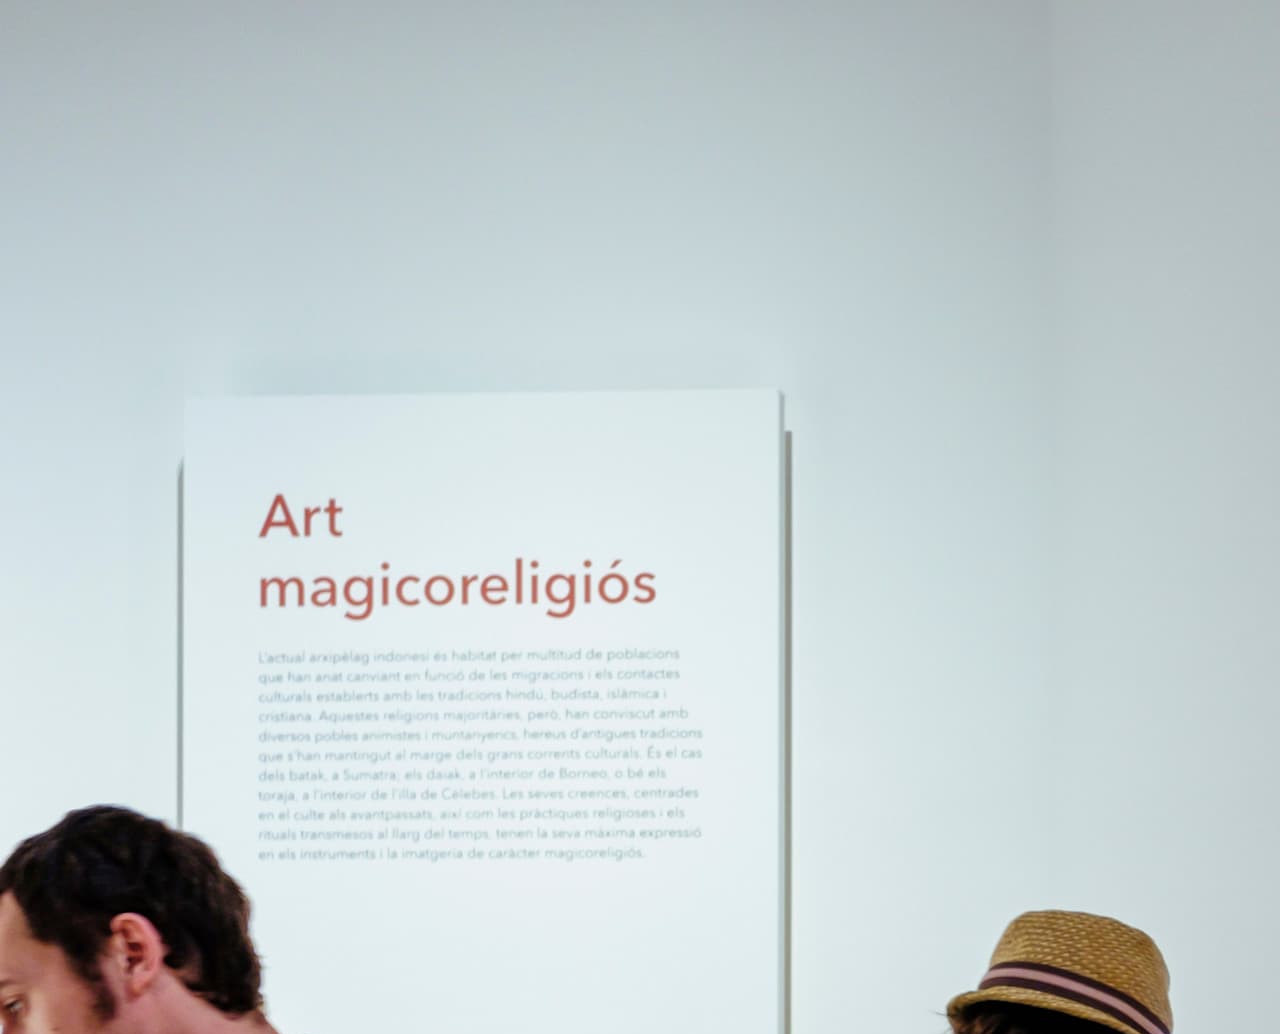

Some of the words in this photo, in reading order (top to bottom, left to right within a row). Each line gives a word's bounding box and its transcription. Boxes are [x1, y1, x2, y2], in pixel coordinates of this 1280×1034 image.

[259, 494, 342, 538] Art
[260, 559, 656, 621] magicoreligiós
[374, 649, 429, 663] indonesi
[452, 648, 496, 663] habitat
[501, 652, 522, 666] per
[526, 648, 582, 662] multitud
[606, 647, 679, 665] poblacions
[258, 673, 284, 687] que
[287, 669, 311, 683] han
[315, 669, 343, 683] anat
[425, 668, 464, 682] funció
[489, 667, 507, 682] les
[512, 668, 584, 685] migracions
[595, 667, 613, 681] els
[617, 667, 680, 681] contactes
[259, 689, 312, 704] culturals
[316, 689, 379, 703] establerts
[383, 688, 412, 702] amb
[416, 688, 434, 702] les
[438, 687, 502, 702] tradicions
[318, 709, 379, 726] Aquestes
[384, 707, 439, 725] religions
[565, 706, 590, 720] han
[593, 706, 655, 720] conviscut
[659, 705, 688, 719] amb
[259, 728, 310, 742] diversos
[315, 727, 358, 745] pobles
[362, 728, 421, 741] animistes
[523, 726, 567, 740] hereus
[640, 725, 702, 739] tradicions
[259, 751, 283, 765] que
[325, 748, 391, 765] mantingut
[410, 750, 452, 764] marge
[456, 746, 483, 761] dels
[487, 750, 524, 764] grans
[527, 747, 581, 760] corrents
[681, 749, 702, 759] cas
[258, 767, 285, 781] dels
[404, 766, 422, 780] els
[648, 765, 666, 779] els
[502, 787, 524, 800] Les
[528, 789, 564, 800] seves
[634, 785, 698, 799] centrades
[294, 806, 325, 820] culte
[329, 806, 346, 820] als
[465, 809, 493, 820] com
[497, 805, 516, 819] les
[593, 805, 656, 823] religioses
[667, 805, 684, 819] els
[259, 826, 296, 840] rituals
[300, 827, 373, 840] transmesos
[424, 825, 445, 840] del
[496, 826, 533, 839] tenen
[552, 829, 581, 839] seva
[278, 846, 296, 860] els
[300, 847, 376, 860] instruments
[402, 847, 463, 864] imatgeria
